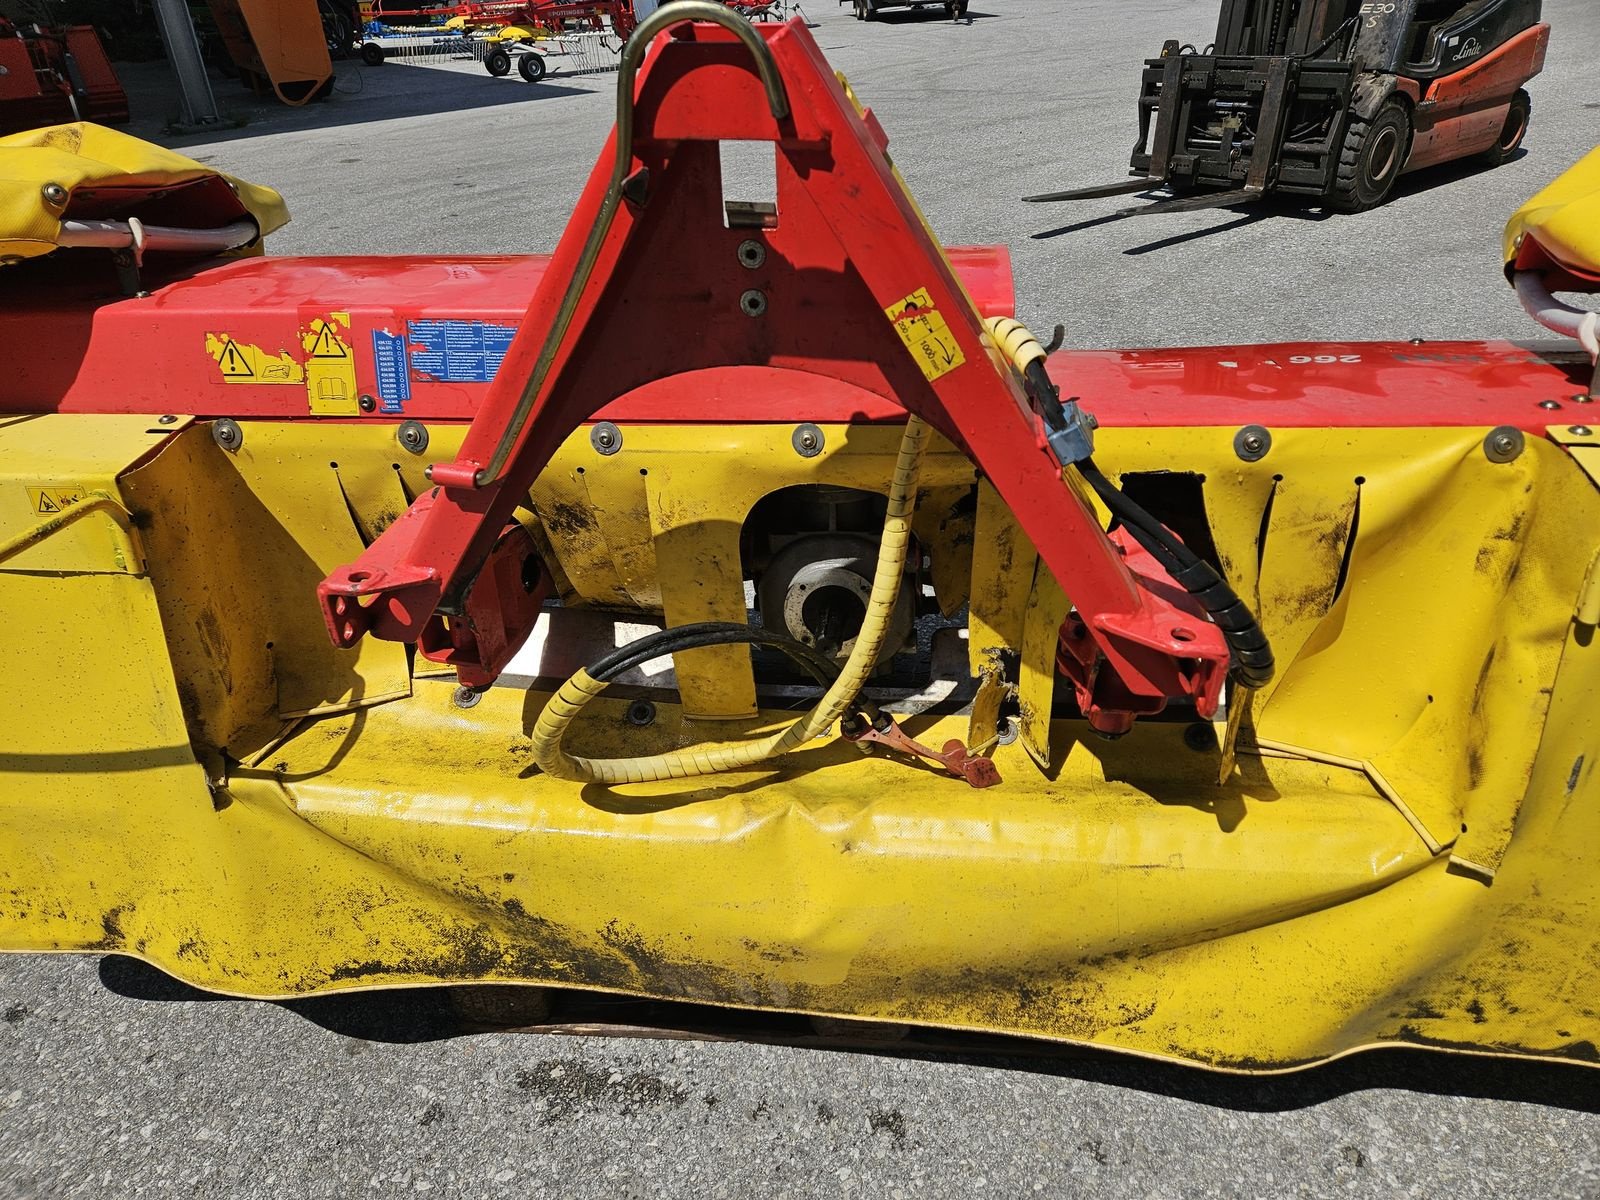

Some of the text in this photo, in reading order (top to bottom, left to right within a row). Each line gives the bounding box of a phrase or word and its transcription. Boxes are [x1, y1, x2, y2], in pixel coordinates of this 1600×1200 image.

[1366, 15, 1380, 28] S
[1452, 37, 1482, 61] Linde
[920, 340, 935, 359] 1000
[1289, 355, 1361, 364] 266
